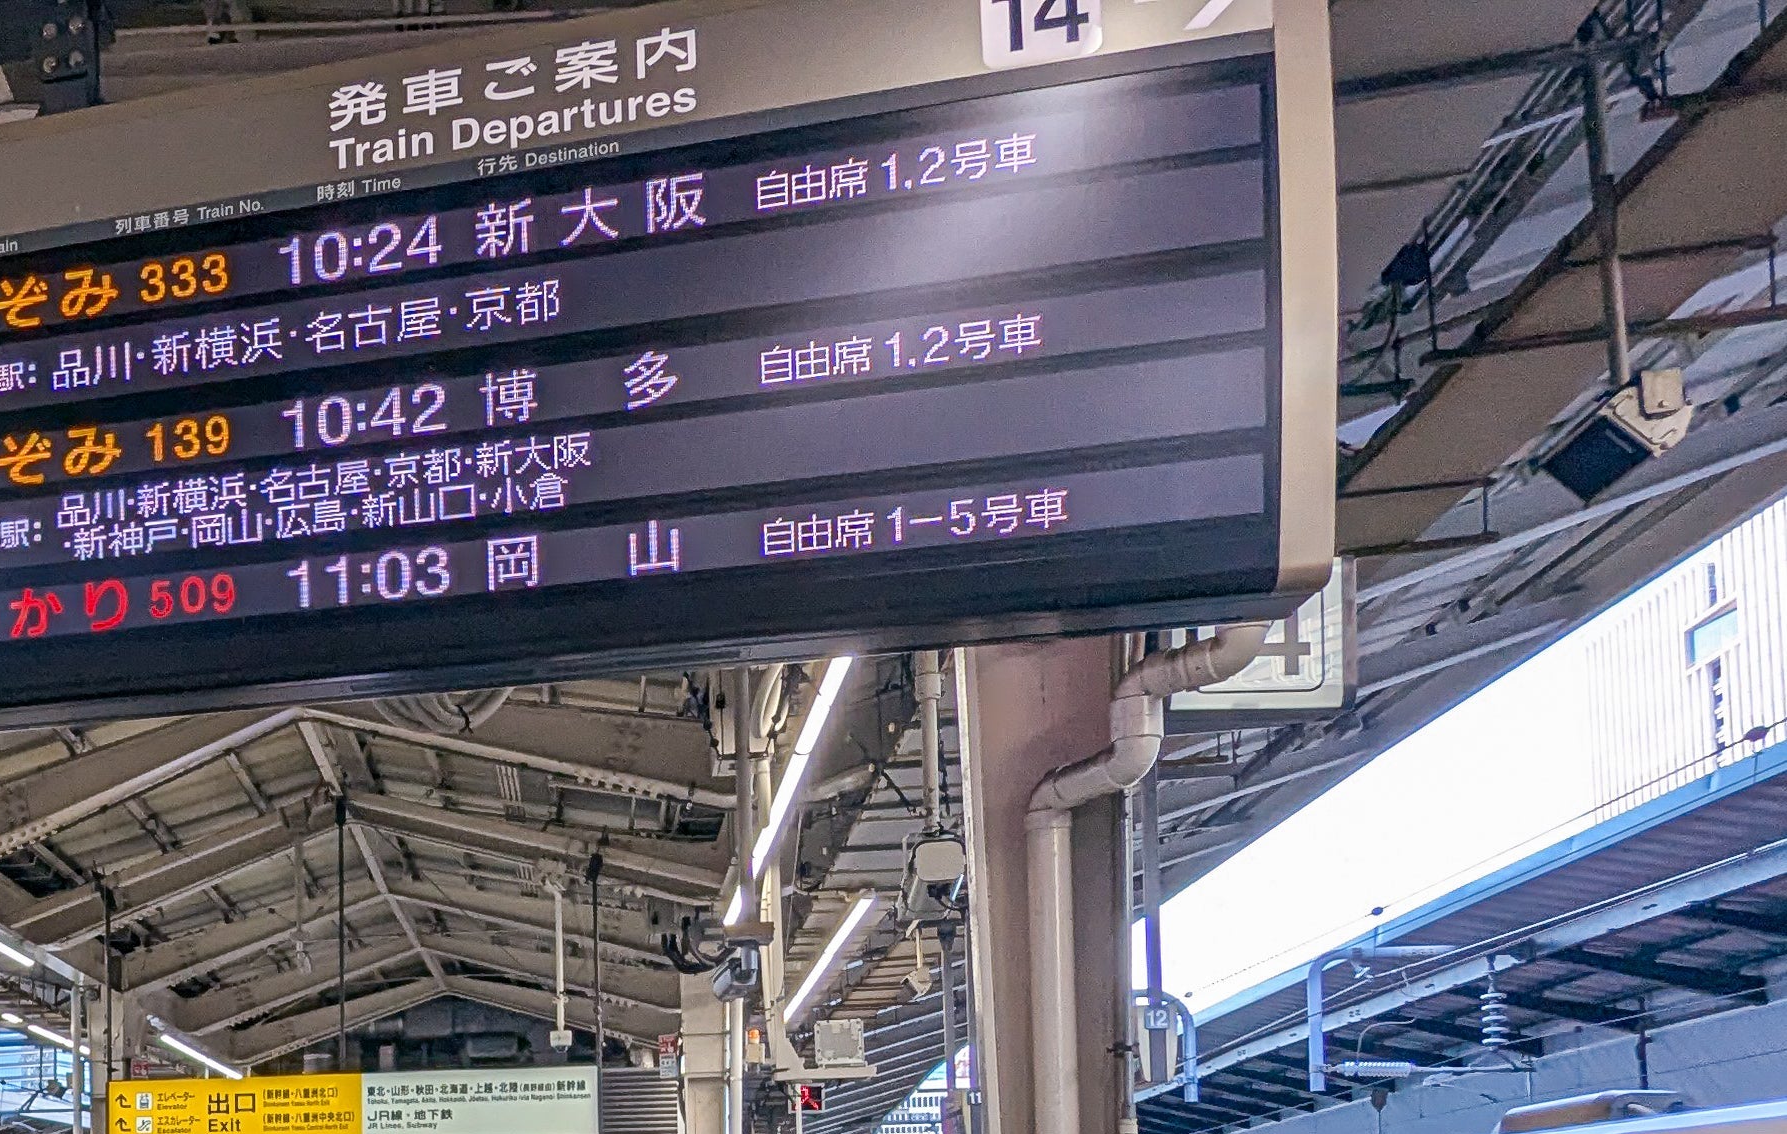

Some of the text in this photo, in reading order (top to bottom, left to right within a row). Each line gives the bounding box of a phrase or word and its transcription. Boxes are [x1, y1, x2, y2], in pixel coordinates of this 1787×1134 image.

[329, 27, 697, 132] 発車ご案内
[330, 86, 697, 170] Train Departures
[477, 140, 619, 177] 行先 Destination
[316, 175, 401, 202] 時刻 Time
[115, 198, 265, 235] 列車番号 Train No.
[140, 254, 228, 303] 333
[279, 215, 442, 285] 10:24
[145, 414, 232, 463] 139
[283, 382, 447, 448] 10:42
[150, 572, 236, 619] 509
[286, 546, 450, 610] 11:03
[1146, 1009, 1168, 1027] 12
[208, 1092, 255, 1115] 出口
[969, 1092, 982, 1104] 11
[208, 1118, 241, 1132] Exit
